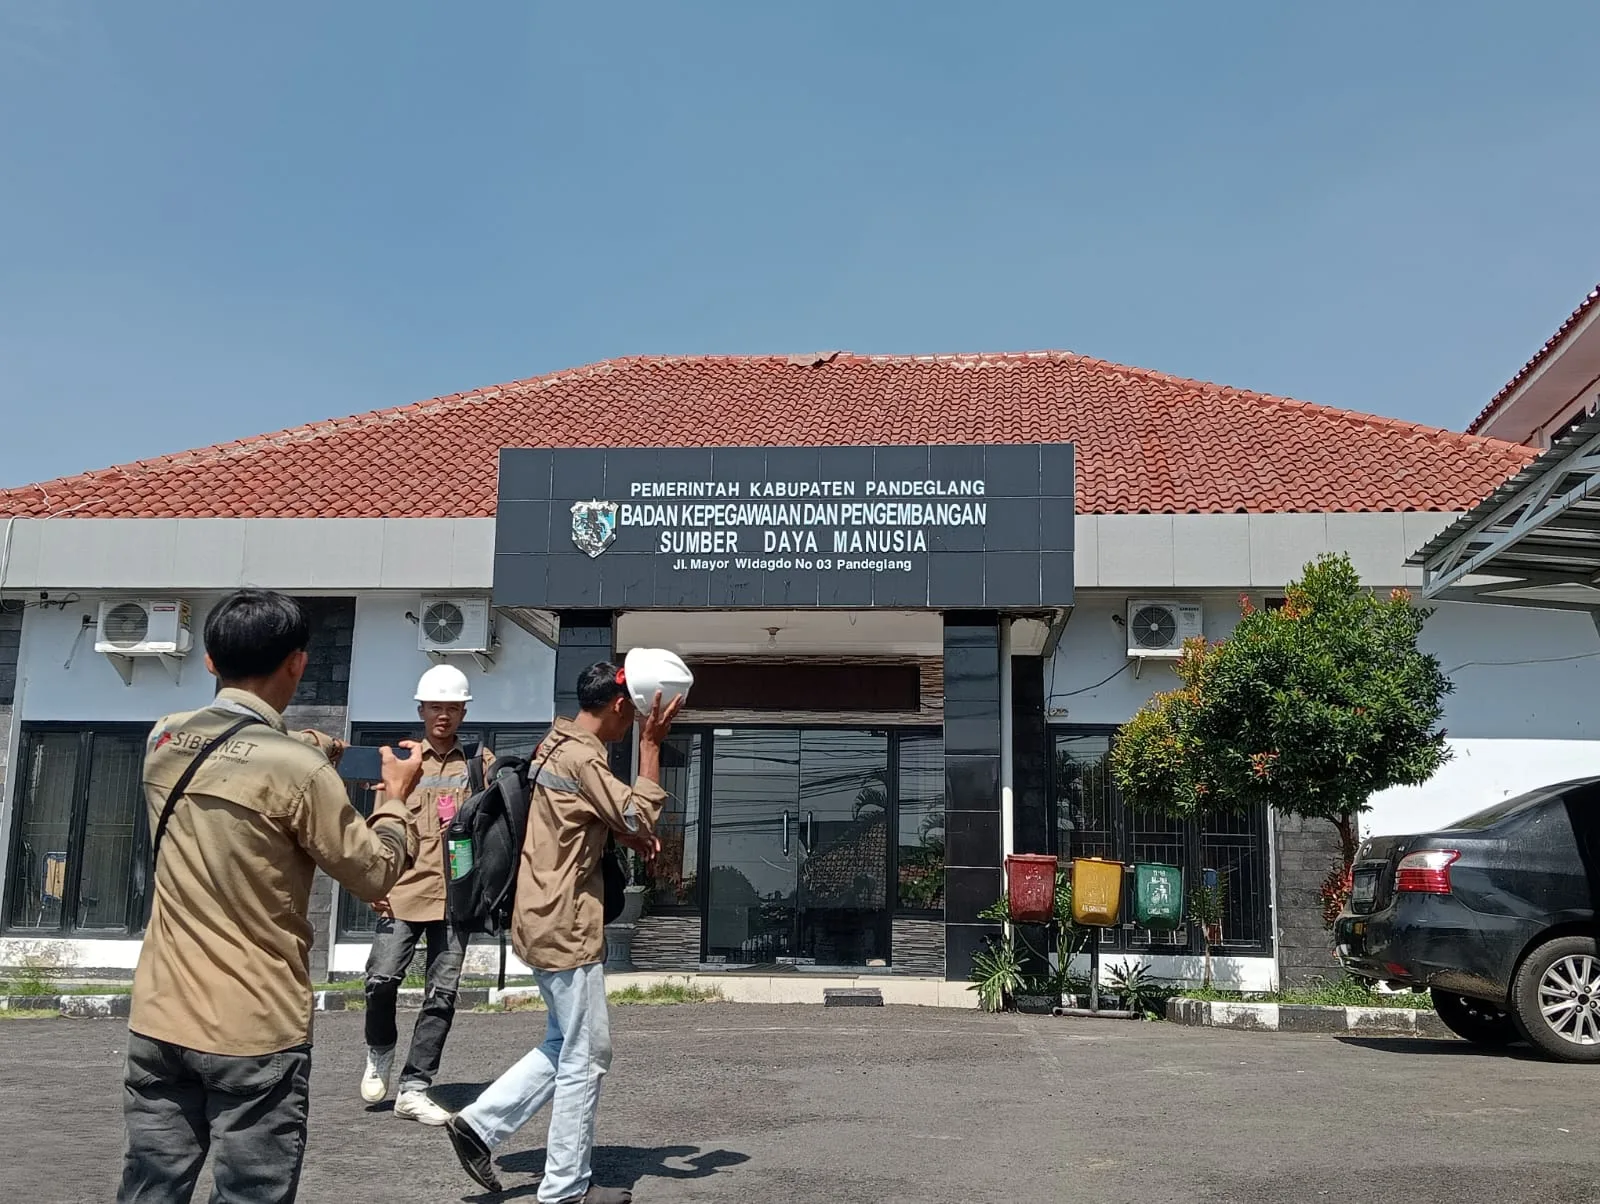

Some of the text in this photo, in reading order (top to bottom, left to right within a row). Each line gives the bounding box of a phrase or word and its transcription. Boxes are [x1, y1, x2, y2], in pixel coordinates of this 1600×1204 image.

[630, 479, 987, 498] PEMERINTAH KABUPATEN PANDEGLANG
[620, 501, 988, 527] BADAN KEPEGAWAIAN DAN PENGEMBANGAN
[659, 527, 927, 554] SUMBER DAYA MANUSIA
[690, 558, 730, 572] Mayor
[795, 558, 813, 570] No
[815, 558, 832, 570] 03
[836, 557, 912, 572] Pandeglang
[172, 731, 259, 757] SIBENET
